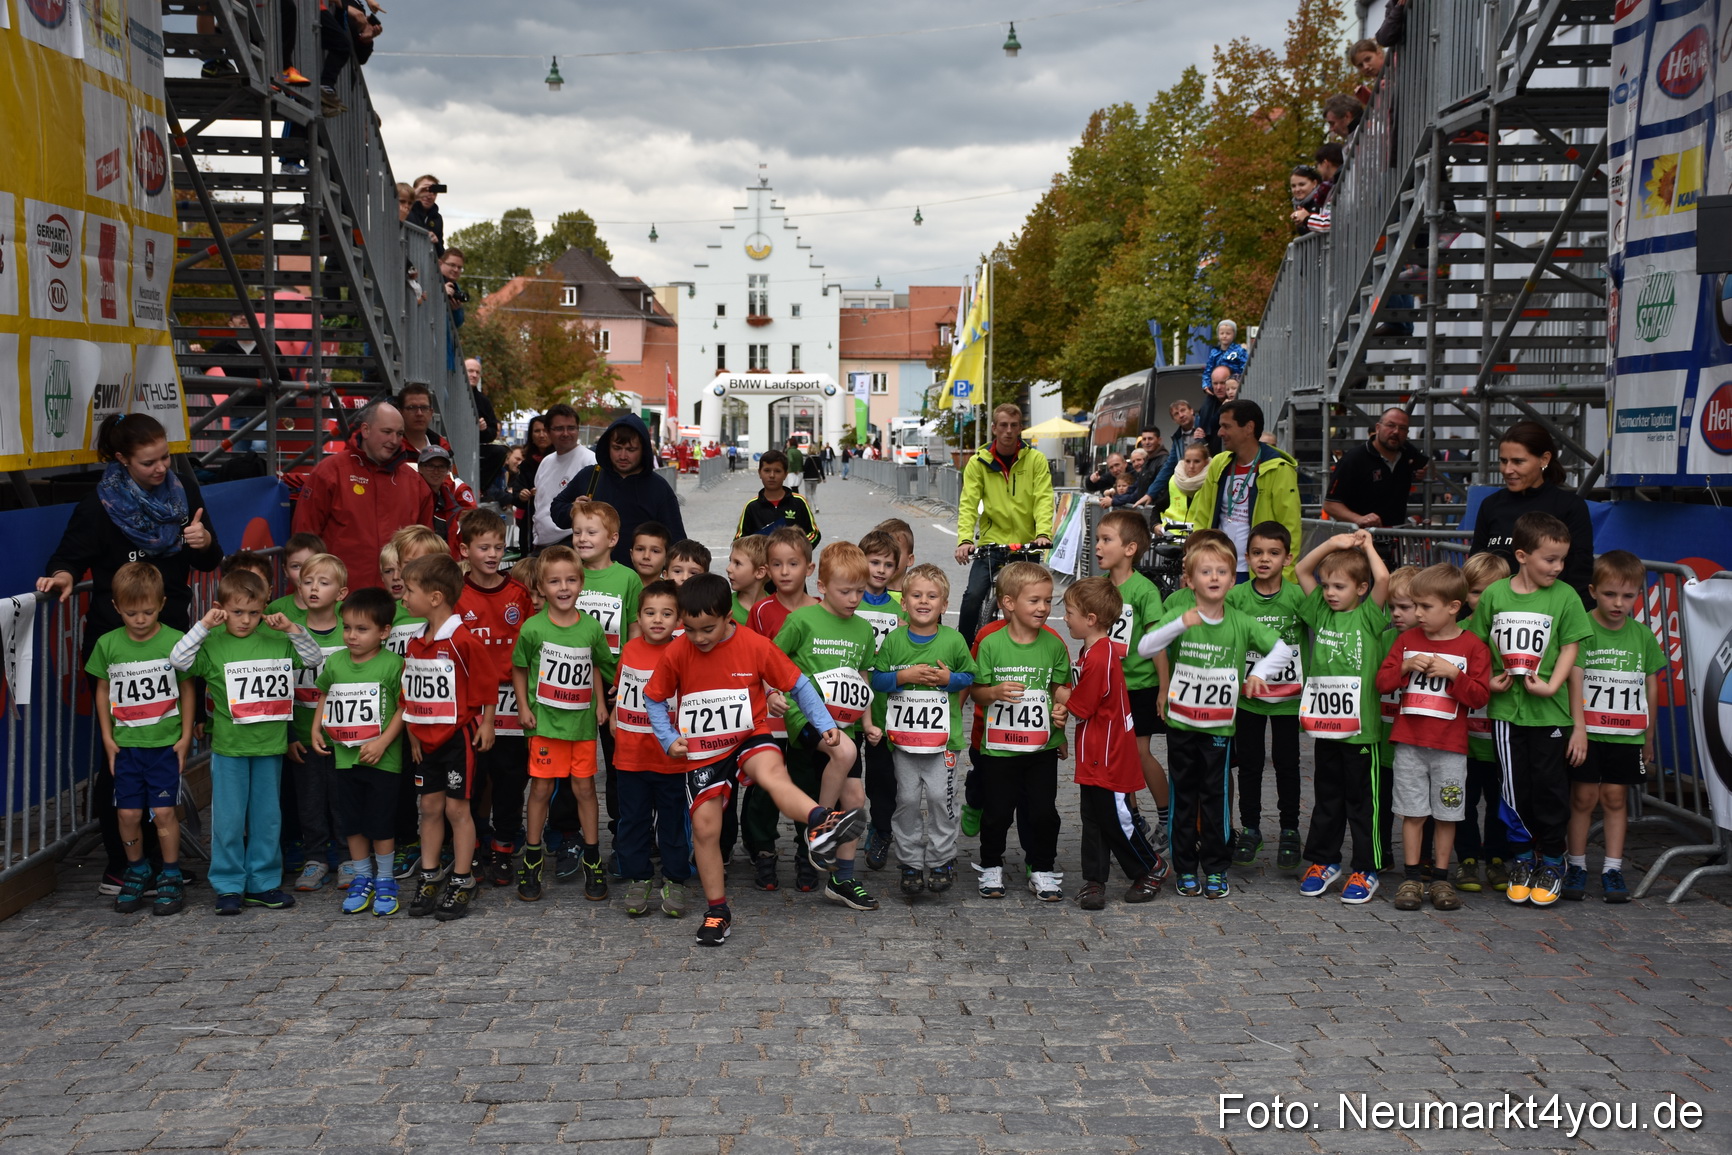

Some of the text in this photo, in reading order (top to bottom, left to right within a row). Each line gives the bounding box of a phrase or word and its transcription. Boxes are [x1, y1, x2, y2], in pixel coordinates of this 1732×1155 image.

[137, 141, 164, 179] Hervis
[37, 224, 66, 242] GERHART
[50, 241, 69, 257] JANIG
[1638, 265, 1676, 307] RUND
[51, 286, 66, 305] KIA
[1635, 304, 1677, 340] SCHAU
[729, 378, 821, 391] BMW Laufsport
[958, 381, 967, 393] P
[1618, 413, 1673, 428] Neumarkter Tagblatt
[580, 600, 610, 608] Neumarkt
[1506, 618, 1541, 626] Neumarkt
[813, 638, 854, 648] Neumarkter
[1494, 627, 1544, 653] 7106
[542, 647, 590, 661] PARTL Neumarkt
[812, 647, 847, 656] Stadtlauf
[1586, 648, 1627, 657] Neumarkter
[127, 667, 161, 677] Neumarkt
[227, 667, 251, 675] PARTL
[546, 659, 591, 686] 7082
[994, 665, 1036, 673] Neumarkter
[1176, 670, 1195, 679] PARTL
[234, 674, 289, 700] 7423
[405, 675, 449, 698] 7058
[1584, 675, 1638, 685] PARTL Neumarkt
[115, 674, 172, 703] 7434
[553, 689, 580, 701] Niklas
[827, 681, 870, 708] 7039
[1178, 680, 1231, 705] 7126
[682, 694, 736, 707] PARTL Neumarkt
[1310, 692, 1353, 715] 7096
[1589, 685, 1640, 711] 7111
[326, 699, 373, 723] 7075
[414, 704, 433, 714] Vitus
[838, 711, 852, 720] Finn
[994, 704, 1044, 728] 7143
[1193, 710, 1210, 720] Tim
[685, 703, 743, 733] 7217
[893, 705, 943, 729] 7442
[1601, 715, 1631, 726] Simon
[336, 730, 358, 739] Timur
[1005, 733, 1029, 743] Kilian
[700, 735, 739, 750] Raphael
